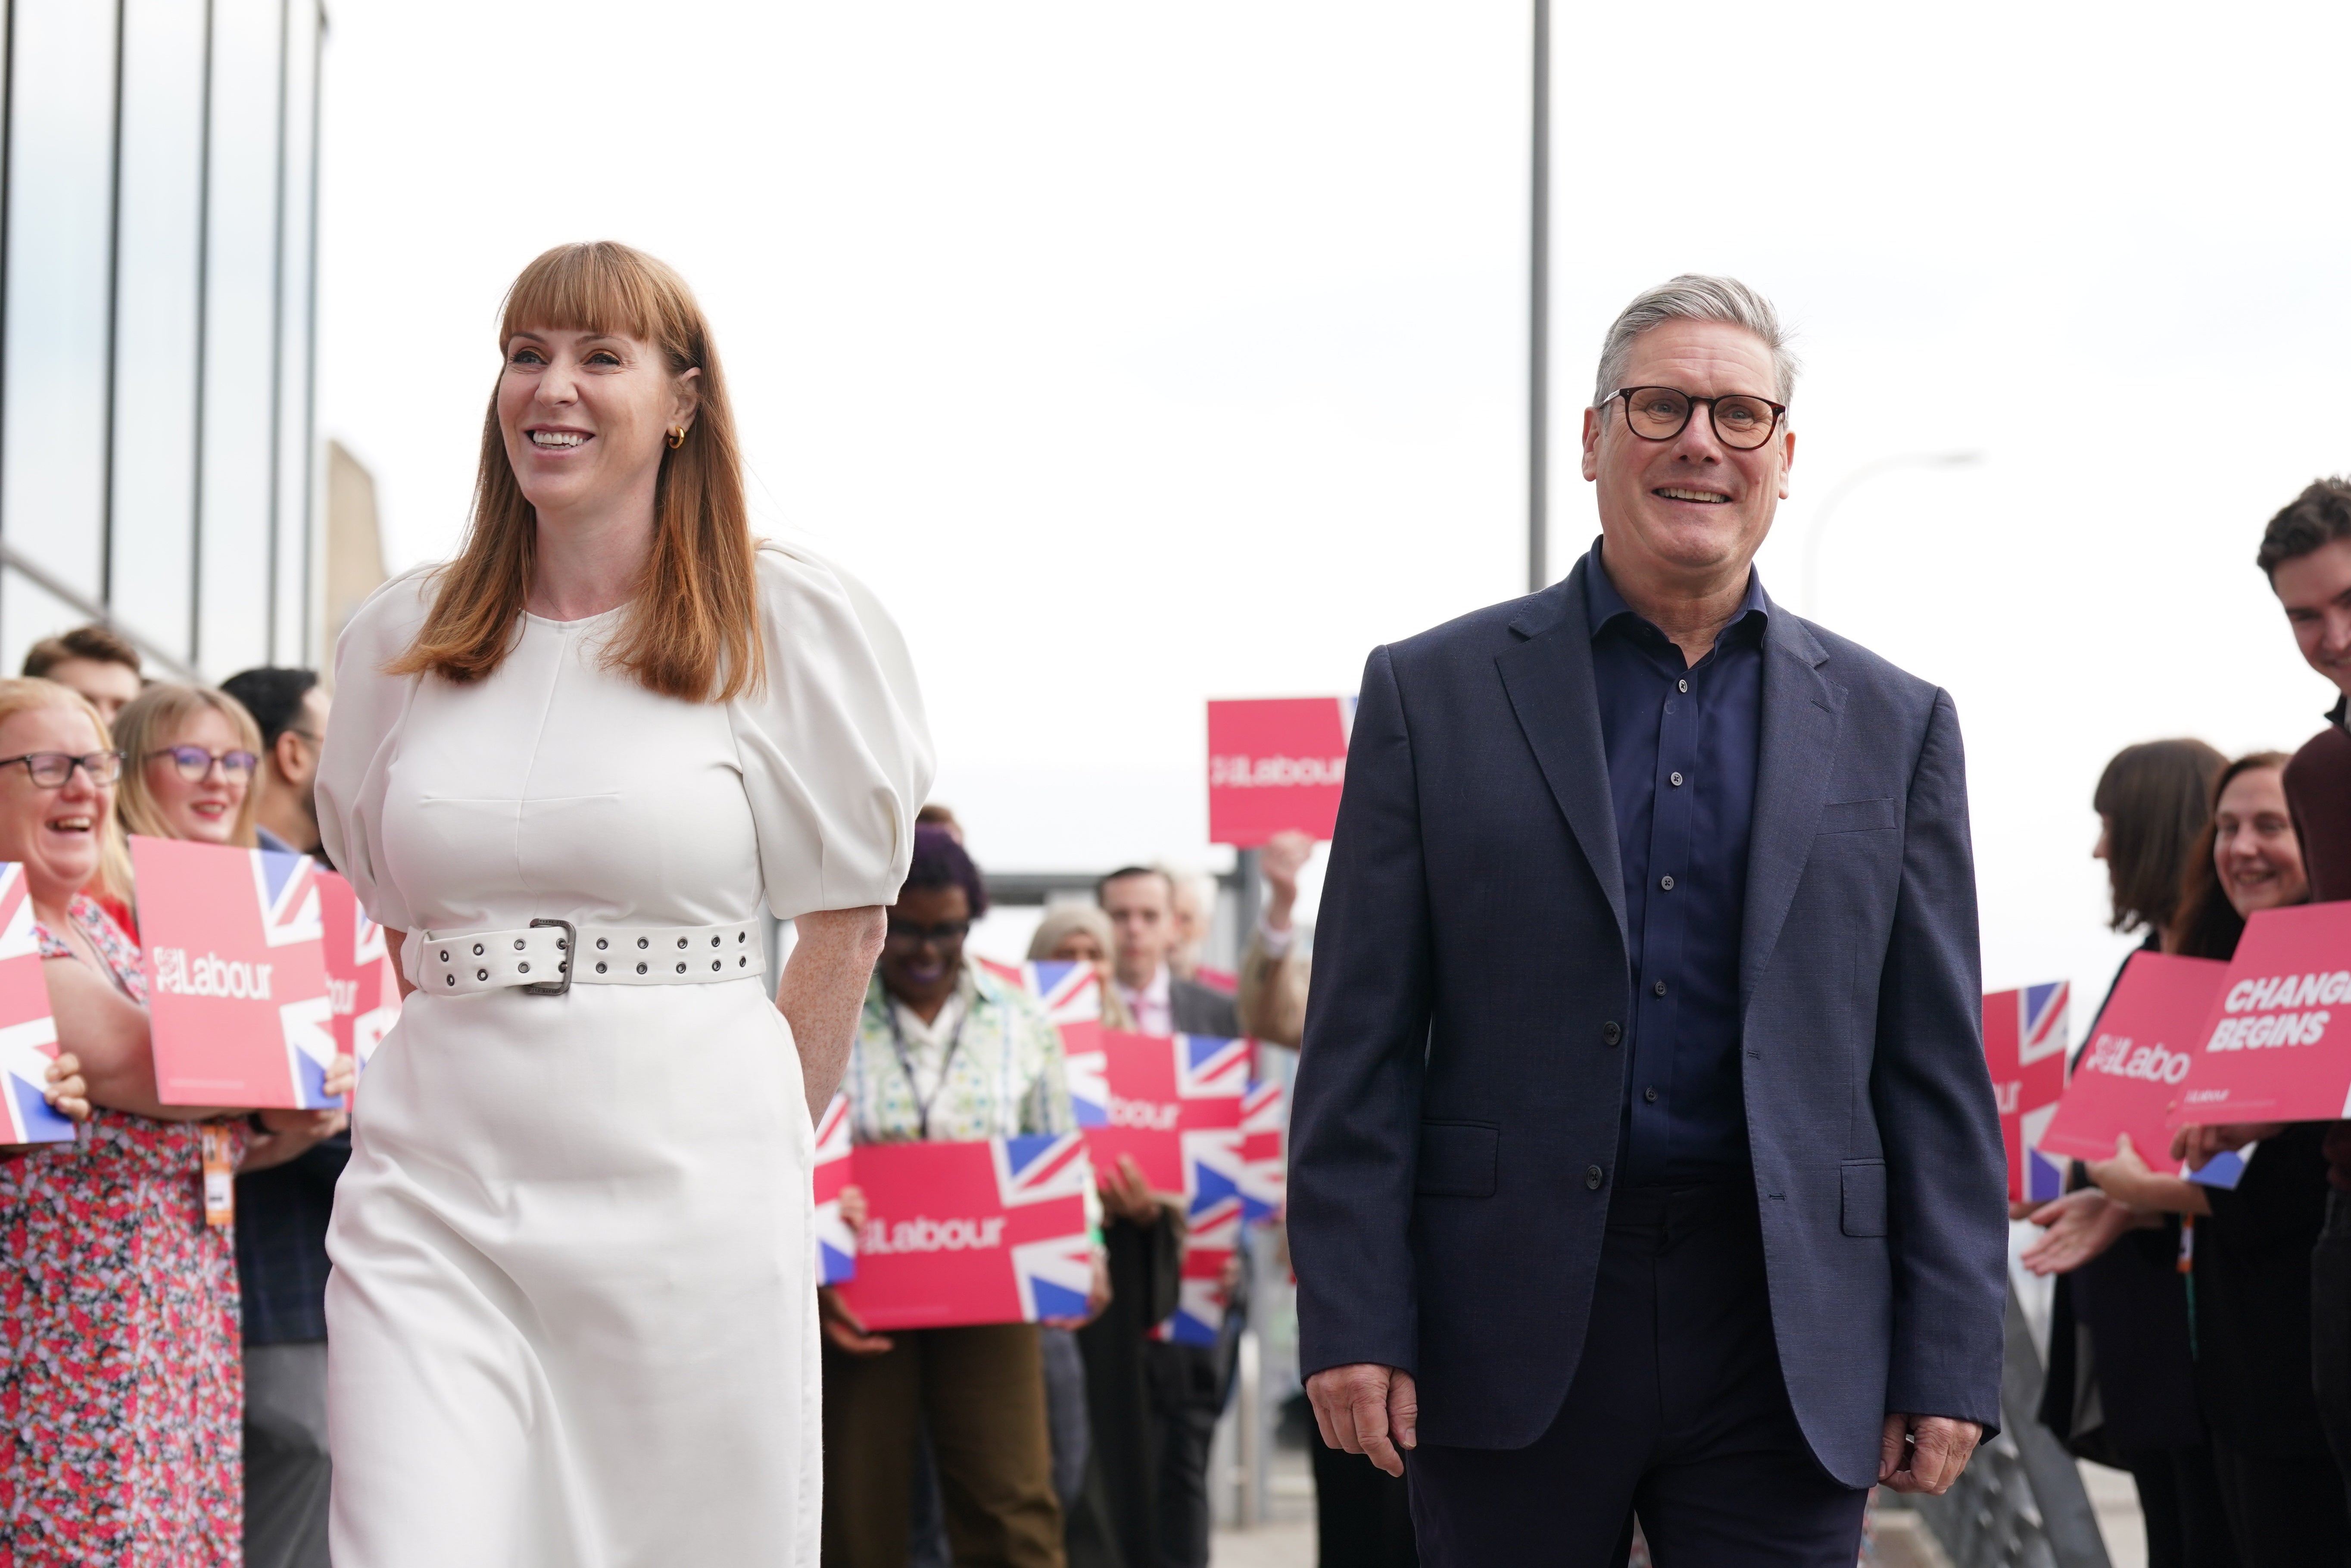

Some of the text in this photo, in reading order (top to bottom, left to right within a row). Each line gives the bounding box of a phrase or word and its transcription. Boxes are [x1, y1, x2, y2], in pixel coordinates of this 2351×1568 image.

[177, 948, 273, 1000] Labour
[2206, 1010, 2331, 1052] BEGINS
[2111, 1037, 2190, 1085] Labo
[1107, 1097, 1181, 1132] bour
[871, 1215, 1007, 1254] Labour
